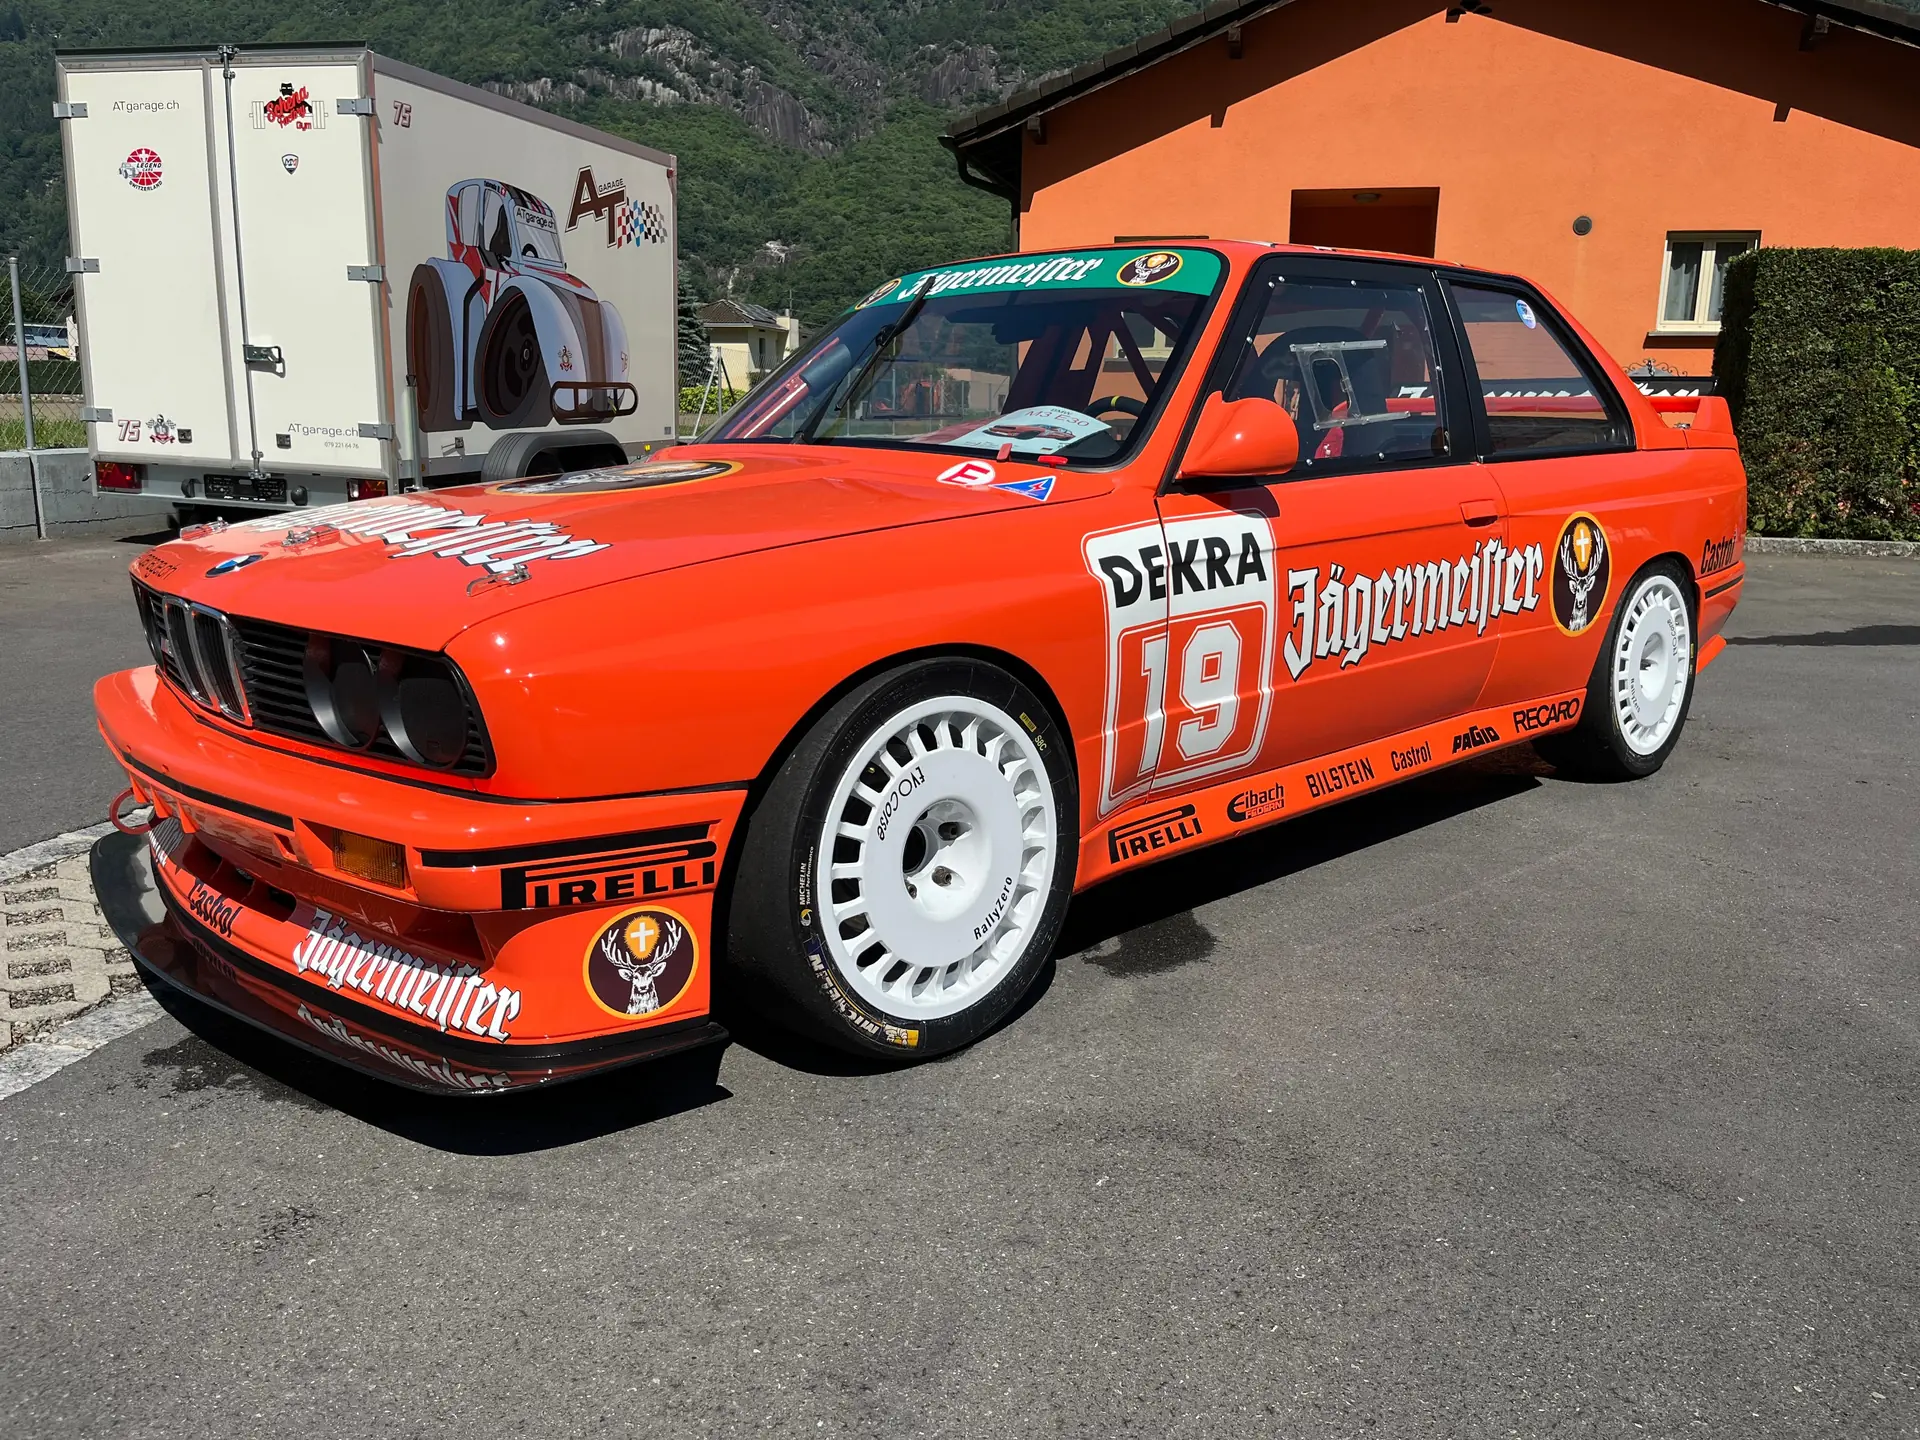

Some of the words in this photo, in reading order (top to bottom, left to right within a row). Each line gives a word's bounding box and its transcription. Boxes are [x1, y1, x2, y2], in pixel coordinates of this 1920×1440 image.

[112, 100, 180, 113] ATgarage.ch
[393, 101, 412, 128] 75
[296, 121, 312, 132] Gym
[128, 180, 163, 192] SWITZERLAND
[598, 178, 624, 193] GARAGE
[117, 419, 141, 442] 75
[288, 423, 359, 438] ATgarage.ch
[1024, 410, 1053, 418] M3
[1053, 413, 1090, 427] E30
[940, 462, 991, 485] E
[1098, 532, 1268, 608] DEKRA
[1136, 619, 1244, 779] 19
[1512, 697, 1580, 734] RECARO
[1034, 734, 1047, 752] S8C
[1451, 725, 1501, 755] PAGID
[1390, 740, 1433, 773] Castrol
[1305, 756, 1376, 799] BILSTEIN
[1226, 782, 1285, 823] Eibach
[1245, 798, 1285, 820] FEDERN
[1107, 803, 1203, 865] PIRELLI
[500, 840, 717, 911] PIRELLI
[798, 862, 808, 906] MICHELIN
[187, 878, 244, 939] Castrol
